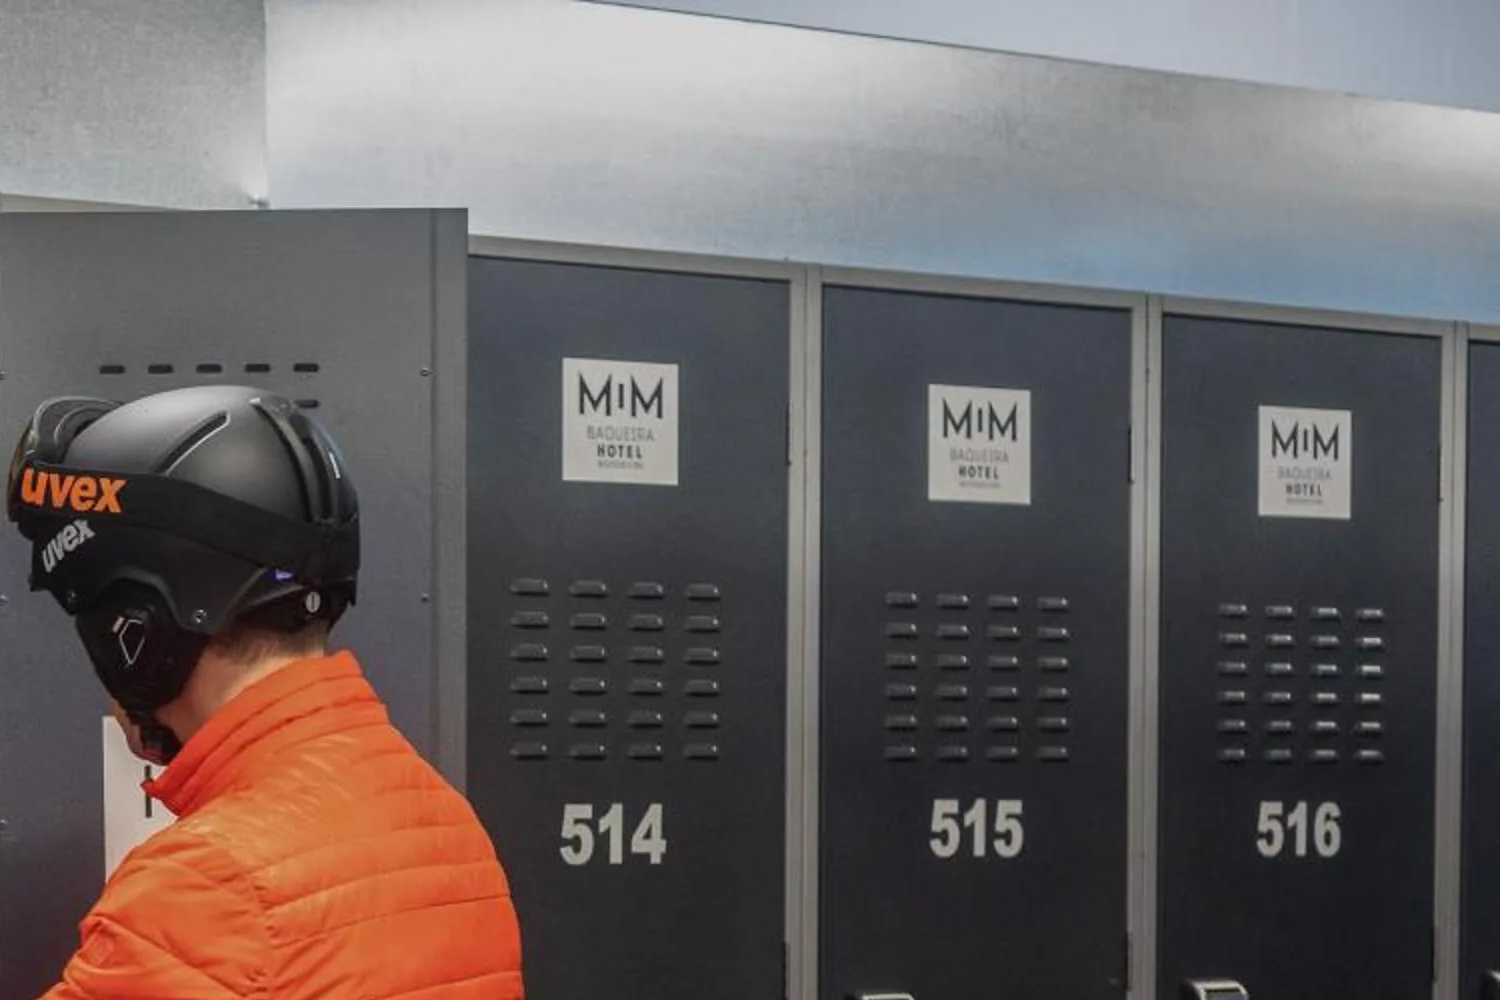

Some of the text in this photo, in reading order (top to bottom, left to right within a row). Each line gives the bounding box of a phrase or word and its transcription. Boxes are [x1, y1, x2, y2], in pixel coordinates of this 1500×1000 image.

[578, 371, 663, 420] MIM
[942, 397, 1018, 442] MIM
[1271, 419, 1339, 461] MIM
[597, 444, 643, 459] HOTEL
[958, 465, 1000, 480] HOTEL
[21, 467, 127, 513] uvex
[41, 519, 97, 573] uvex
[560, 803, 667, 866] 514
[929, 798, 1024, 858] 515
[1256, 800, 1342, 858] 516
